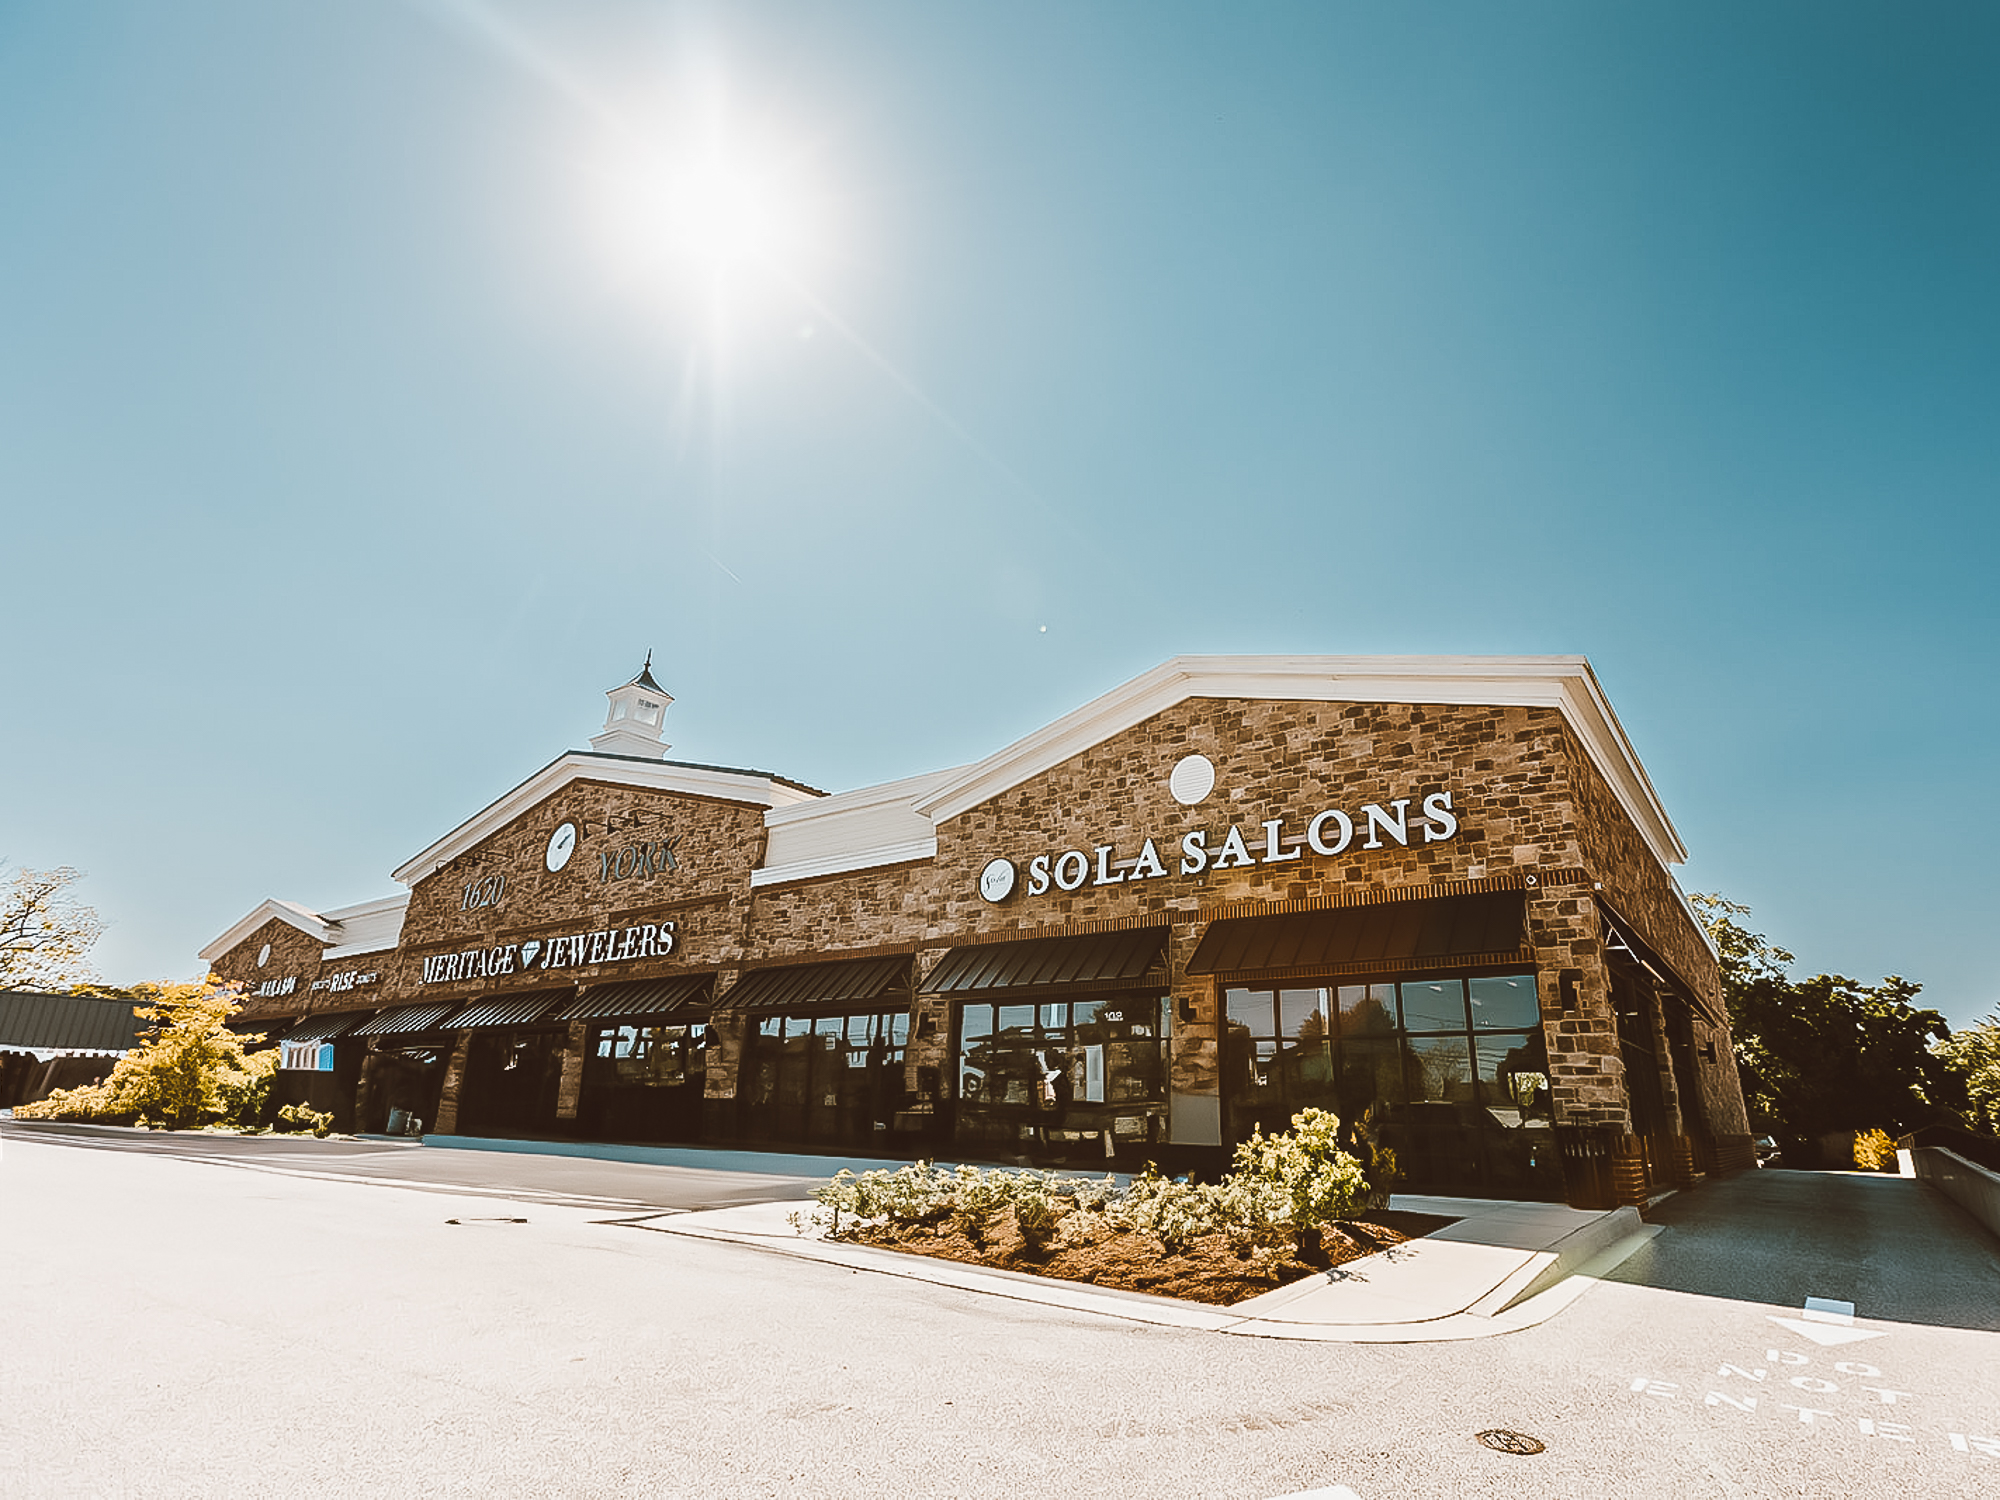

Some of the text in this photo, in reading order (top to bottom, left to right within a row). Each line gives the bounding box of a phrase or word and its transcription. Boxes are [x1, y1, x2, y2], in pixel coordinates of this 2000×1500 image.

[600, 834, 684, 883] YORK
[1027, 791, 1458, 896] SOLA SALONS
[461, 875, 505, 911] 1620
[541, 921, 674, 969] JEWELERS
[1717, 1362, 1912, 1404] NOT
[1766, 1349, 1881, 1377] DO
